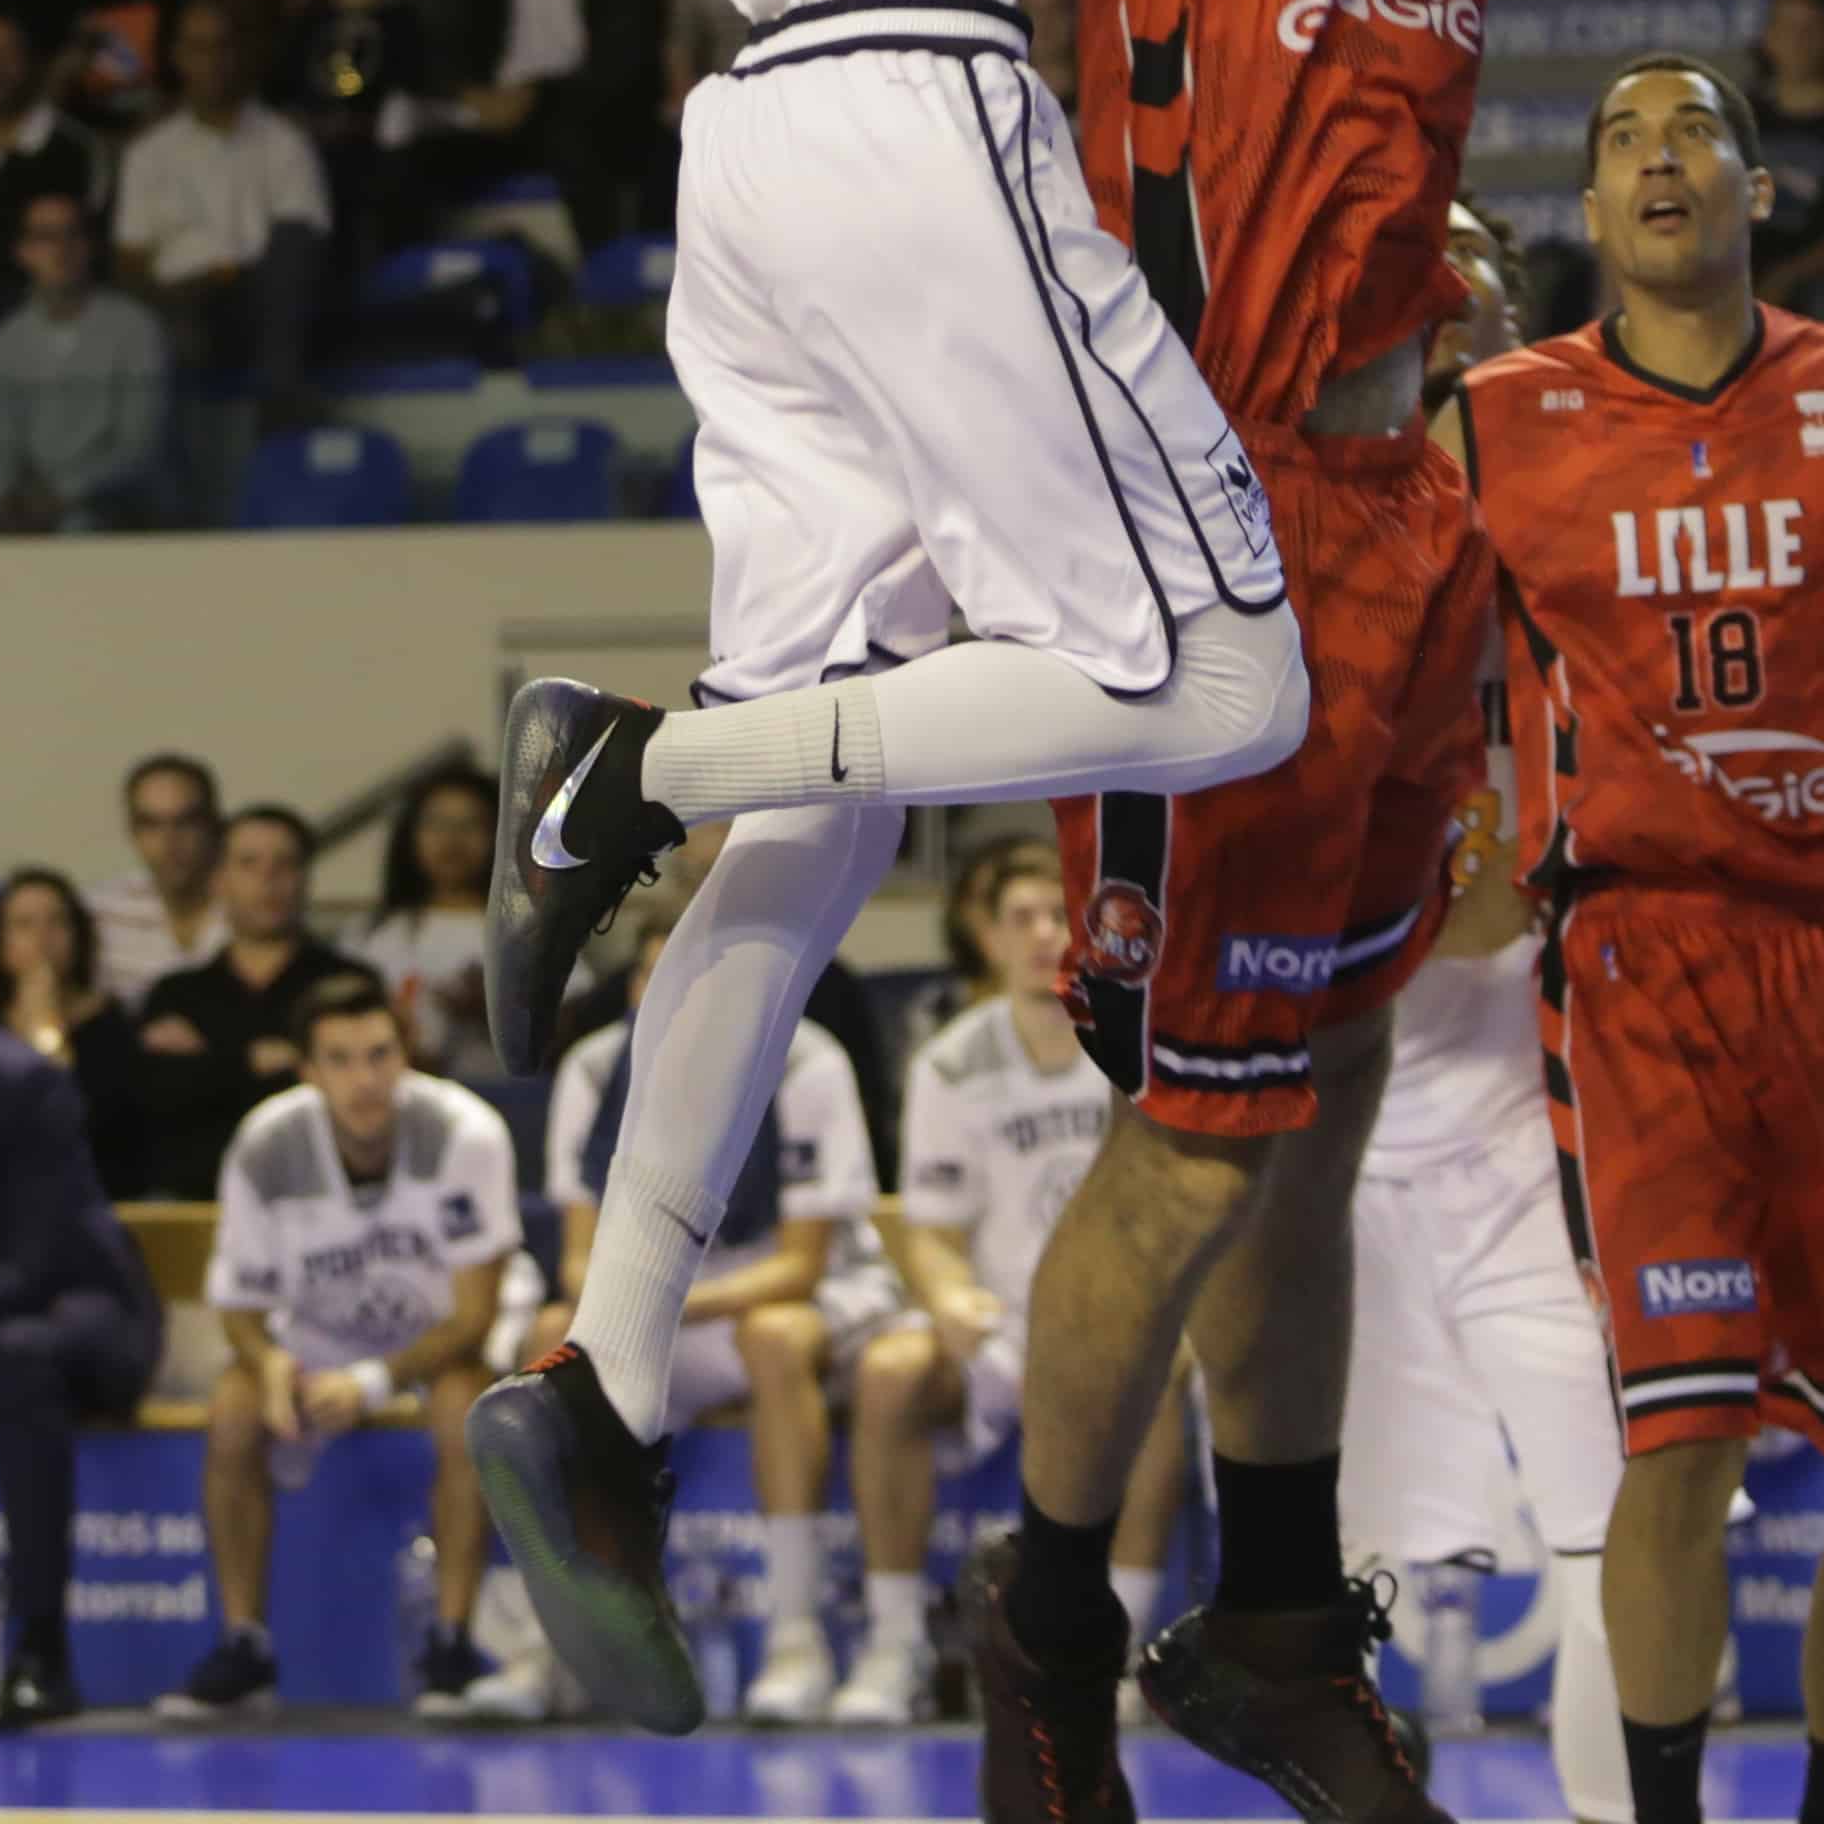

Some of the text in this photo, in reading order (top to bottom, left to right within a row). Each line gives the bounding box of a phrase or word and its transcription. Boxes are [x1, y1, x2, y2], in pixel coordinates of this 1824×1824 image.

[1611, 498, 1806, 598] LILLE
[1667, 606, 1766, 712] 18
[1644, 1261, 1756, 1304] Nord
